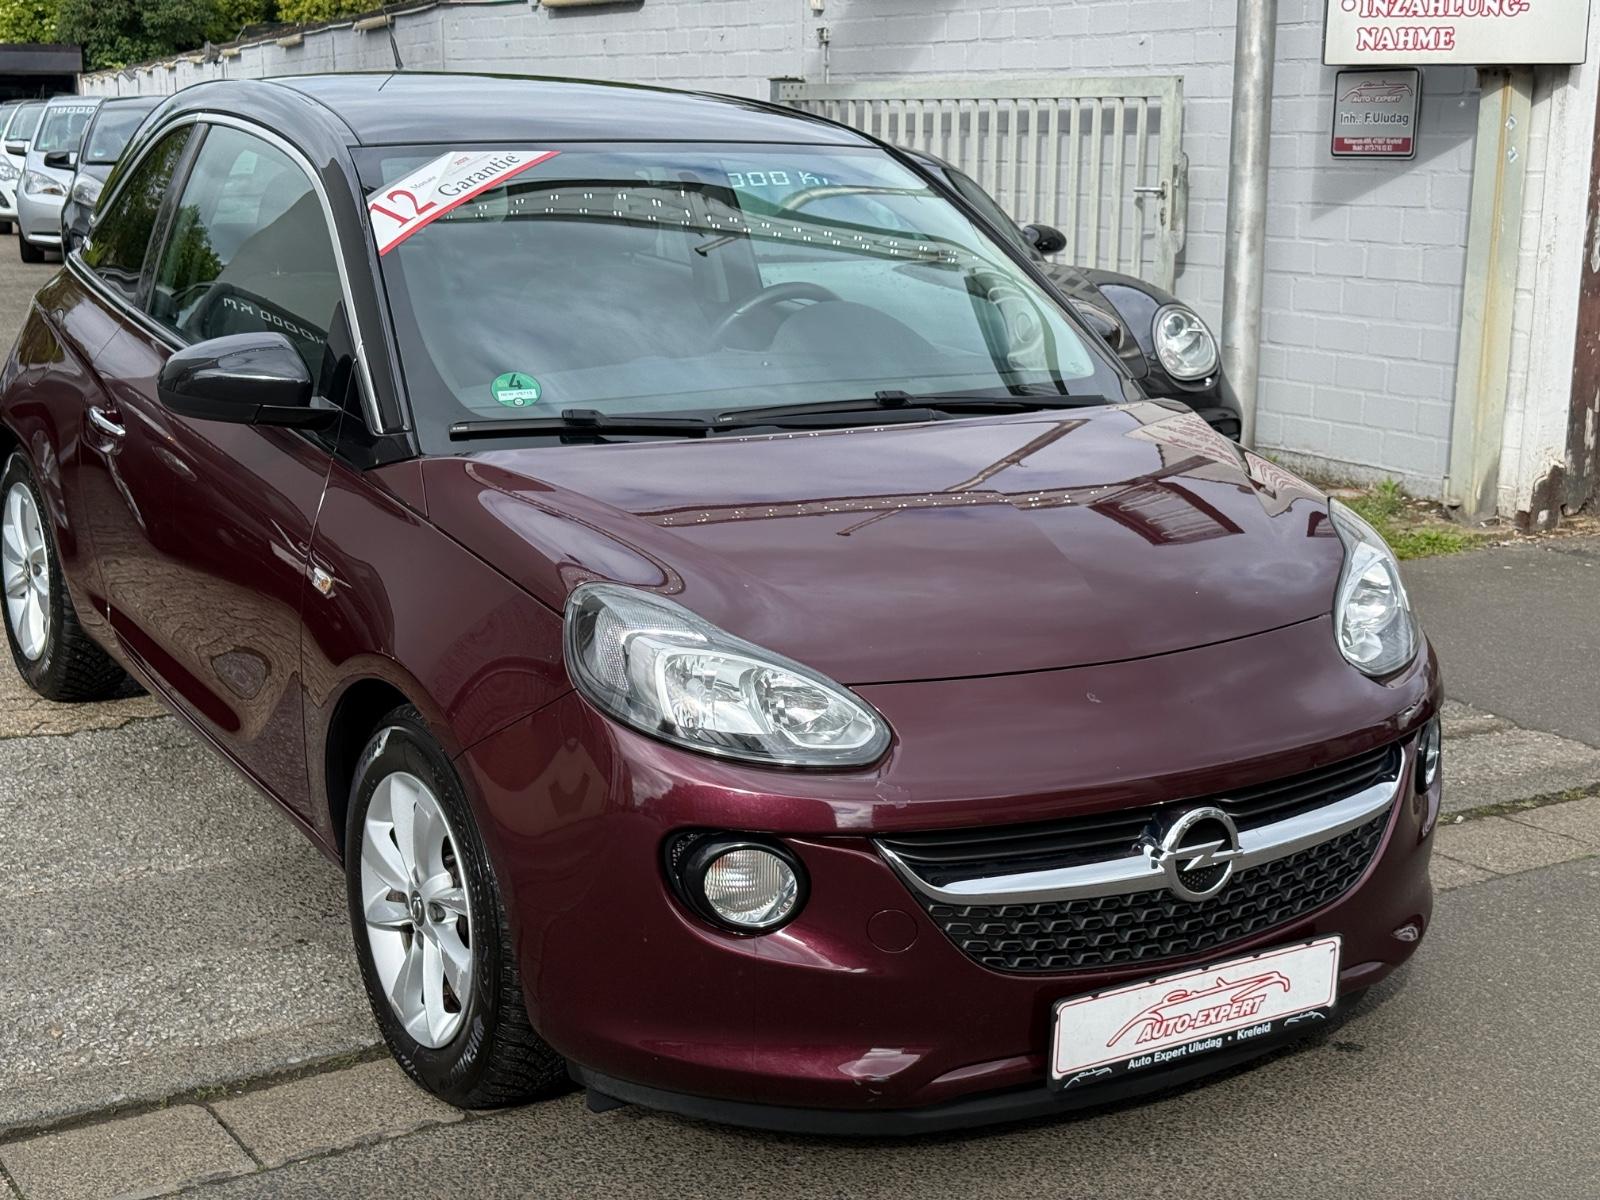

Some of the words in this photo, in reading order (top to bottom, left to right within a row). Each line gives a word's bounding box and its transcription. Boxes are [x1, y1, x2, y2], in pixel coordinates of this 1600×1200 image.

[1359, 0, 1530, 18] INZAHLUNG-
[1356, 27, 1455, 50] NAHME
[1364, 112, 1409, 126] F.Uludag
[369, 189, 438, 228] 12
[438, 152, 521, 197] Garantie
[509, 373, 523, 390] 4
[1128, 1055, 1151, 1070] Auto
[1154, 1045, 1187, 1063] Expert
[1188, 1036, 1223, 1055] Uludag
[1236, 1023, 1271, 1040] Krefeld
